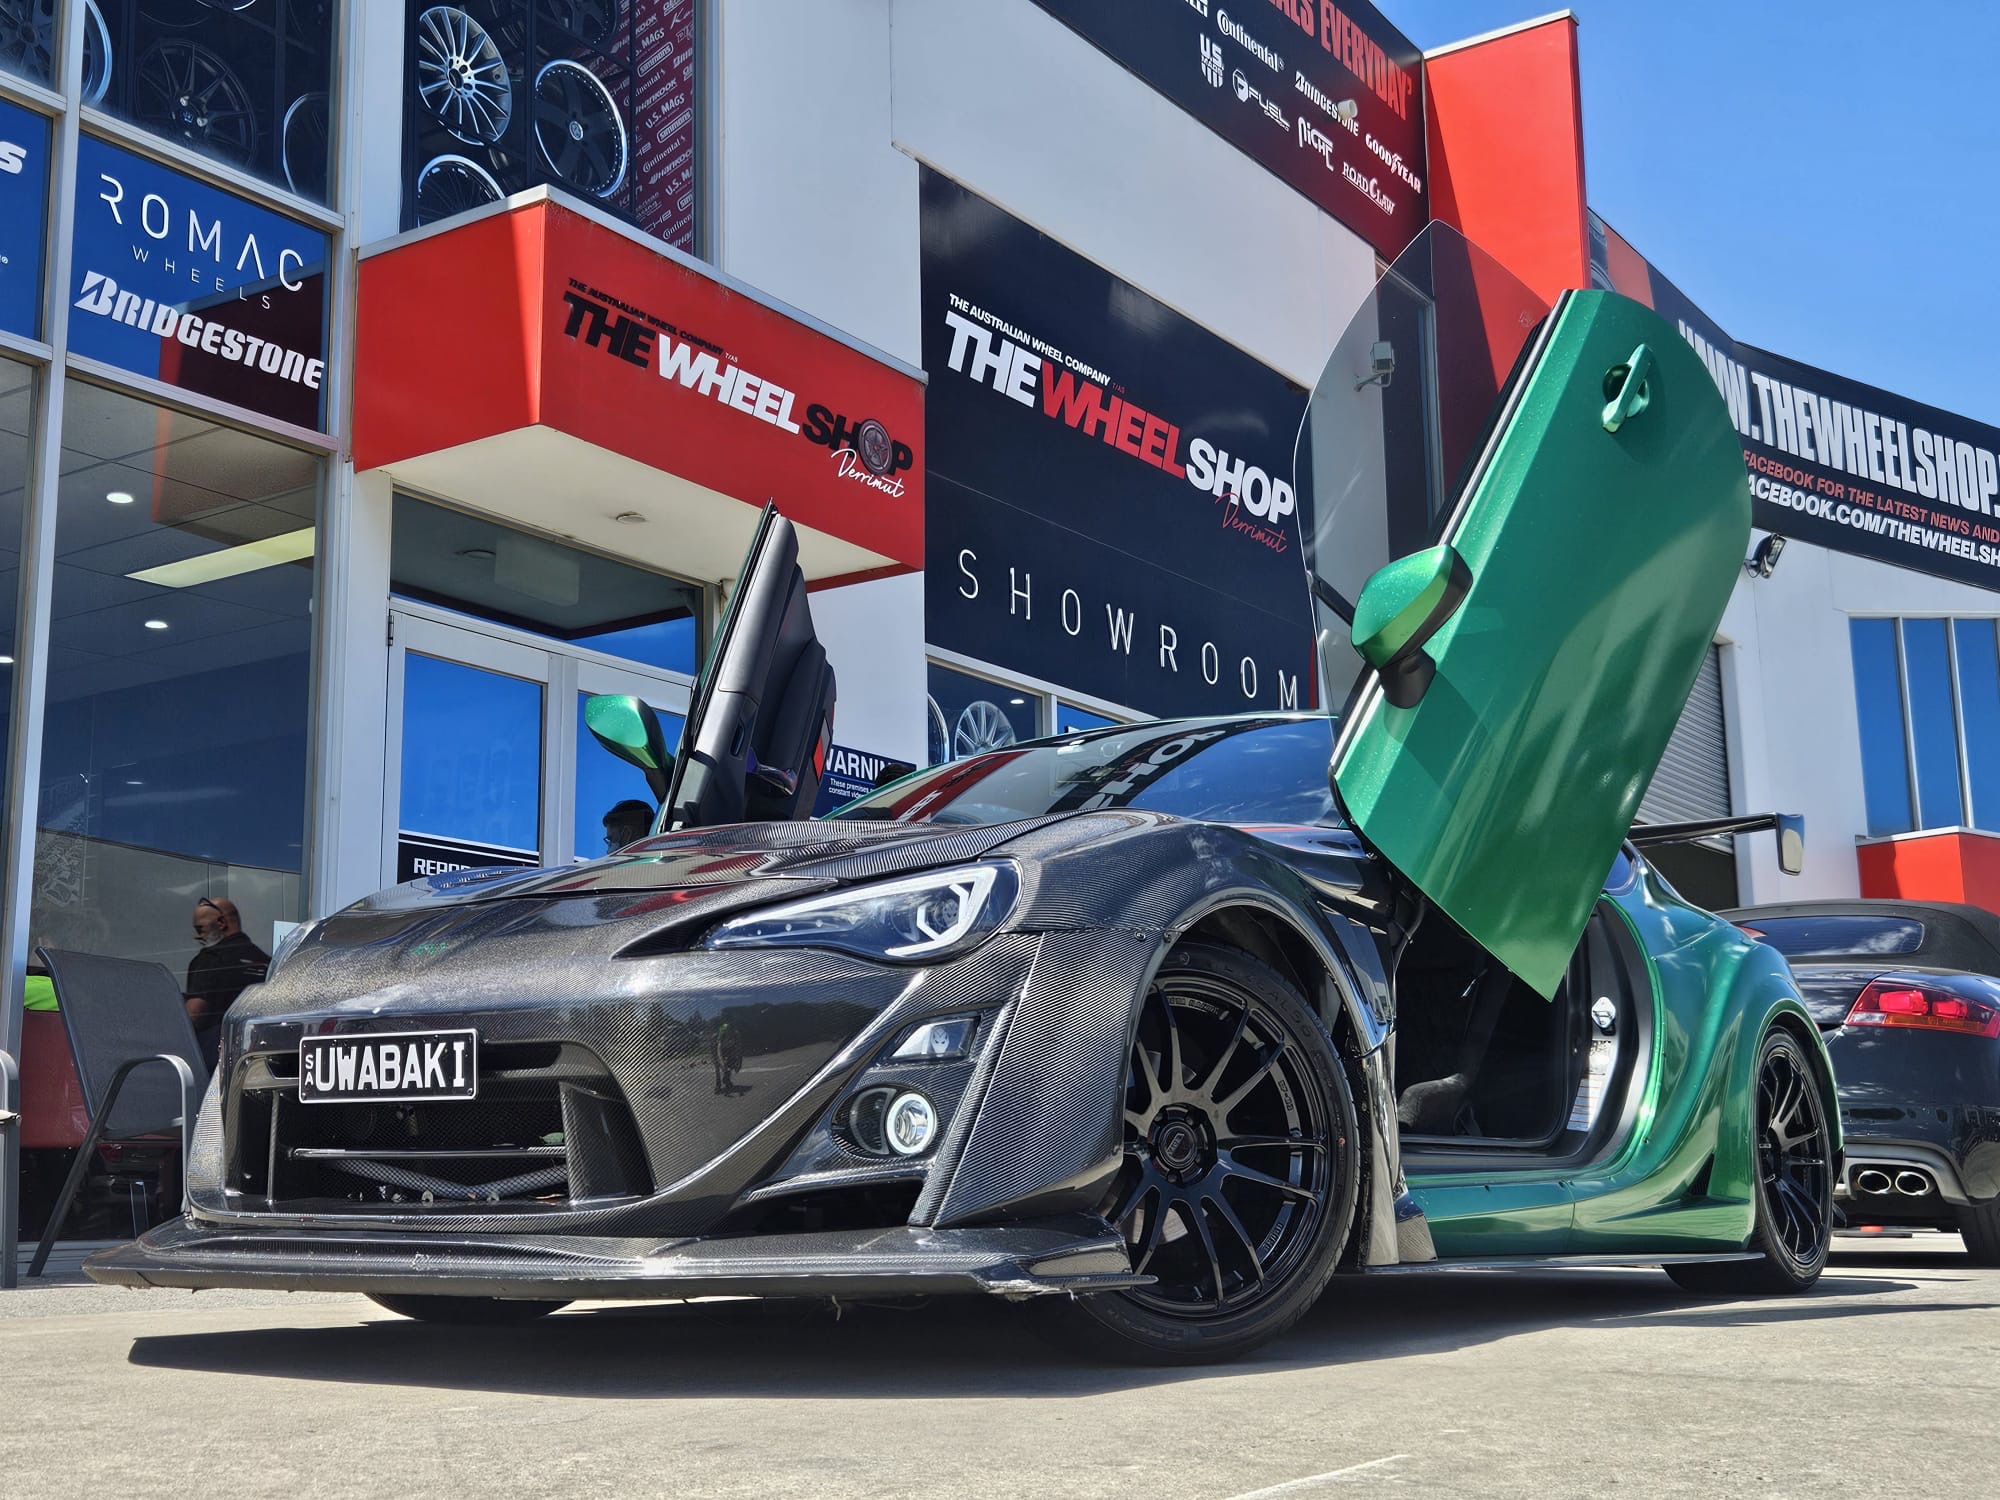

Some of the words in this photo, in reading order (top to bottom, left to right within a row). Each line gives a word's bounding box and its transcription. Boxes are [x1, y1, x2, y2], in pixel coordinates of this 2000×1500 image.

[1365, 133, 1422, 194] GOODYEAR
[100, 172, 304, 292] ROMAC
[131, 244, 271, 310] WHEELS
[73, 269, 325, 390] BRIDGESTONE
[563, 290, 657, 369] THE
[658, 333, 800, 435] WHEEL
[949, 292, 970, 313] THE
[970, 304, 1031, 346] AUSTRALIAN
[1031, 335, 1064, 364] WHEEL
[1064, 354, 1111, 387] COMPANY
[944, 309, 1043, 409] THE
[1042, 359, 1186, 481] WHEEL
[1185, 438, 1295, 525] SHOP
[830, 448, 905, 498] Derrimut
[1748, 473, 2000, 568] ACEBOOK.COM/THEWHEELSH
[1816, 477, 1846, 500] FOR
[1847, 487, 1875, 508] THE
[1876, 495, 1929, 523] LATEST
[1929, 511, 1970, 536] NEWS
[1972, 524, 2000, 544] AND
[958, 548, 1298, 711] SHOWROOM
[315, 1041, 466, 1092] UWABAKI
